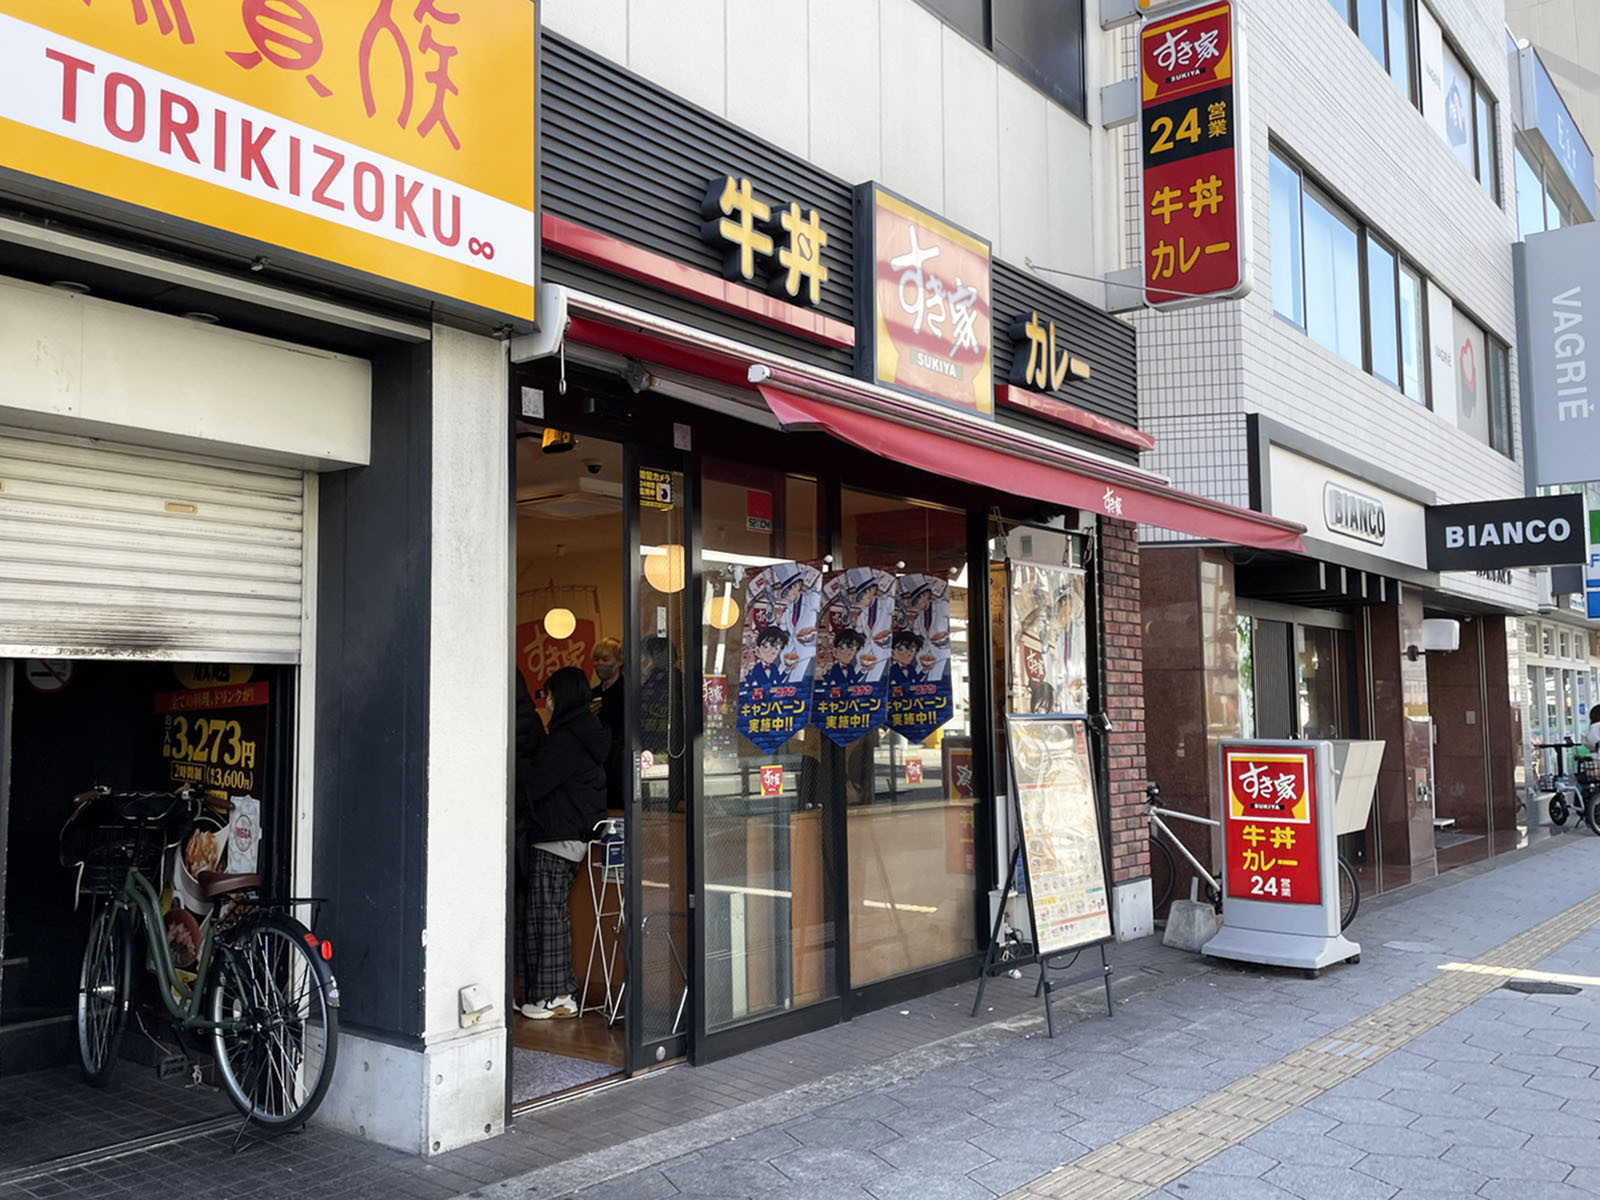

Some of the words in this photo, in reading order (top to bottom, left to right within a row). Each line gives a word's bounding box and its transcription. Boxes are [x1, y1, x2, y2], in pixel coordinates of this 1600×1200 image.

[1152, 28, 1220, 72] すき家
[1170, 68, 1202, 83] SUKIYA
[45, 47, 463, 247] TORIKIZOKU
[1149, 107, 1202, 154] 24
[1207, 100, 1227, 138] 営業
[1151, 175, 1223, 224] 牛丼
[719, 174, 829, 305] 牛丼
[1151, 236, 1231, 281] カレー
[890, 224, 980, 358] すき家
[916, 351, 958, 378] SUKIYA
[1024, 311, 1092, 392] カレー
[1334, 489, 1386, 539] BIANCO
[1445, 518, 1571, 549] BIANCO
[741, 699, 806, 718] キャンペーン
[817, 698, 882, 714] キャンペーン
[172, 715, 256, 768] 3,273円
[1239, 761, 1297, 804] すき家
[1242, 824, 1297, 850] 牛丼
[1242, 848, 1298, 872] カレー
[1250, 875, 1278, 896] 24
